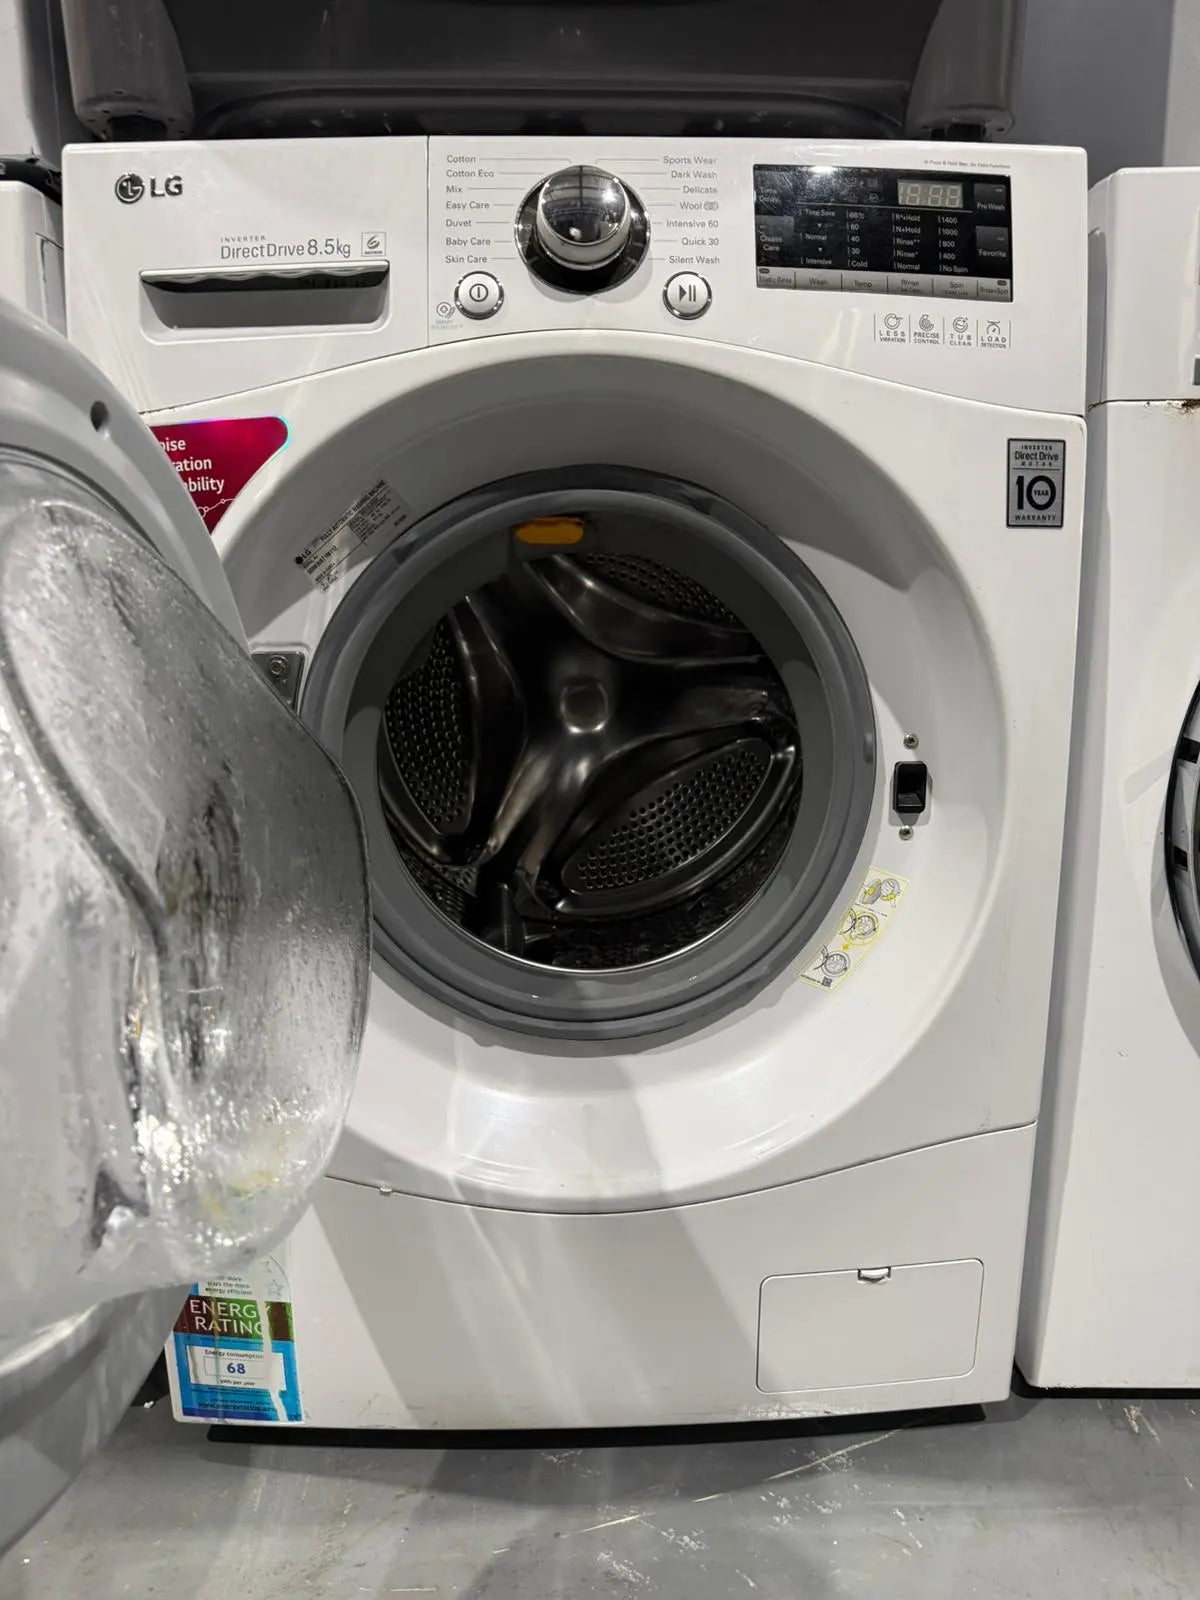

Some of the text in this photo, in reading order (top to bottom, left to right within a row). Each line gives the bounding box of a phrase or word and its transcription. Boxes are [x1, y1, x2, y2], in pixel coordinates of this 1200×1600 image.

[446, 154, 477, 164] Cotton
[663, 155, 717, 165] Sports Wear
[446, 168, 495, 178] Cotton Eco
[671, 170, 718, 180] Dark Wash
[150, 175, 183, 198] LG
[446, 185, 463, 194] Mix
[683, 185, 718, 195] Delicate
[446, 200, 490, 211] Easy Care
[680, 201, 703, 210] Wool
[445, 219, 472, 228] Duvet
[666, 219, 719, 229] Intensive 60
[220, 235, 267, 243] INVERTER
[445, 236, 491, 247] Baby Care
[681, 237, 720, 247] Quick 30
[307, 238, 351, 258] 8.5kg
[445, 255, 488, 264] Skin Care
[668, 256, 720, 265] Silent Wash
[850, 259, 868, 268] Cold
[913, 331, 940, 339] PRECISE
[950, 333, 972, 341] TUB
[981, 335, 1007, 343] LOAD
[1014, 450, 1059, 461] Direct Drive
[1015, 474, 1057, 511] 10
[1033, 489, 1050, 497] YEAR
[1015, 513, 1057, 522] WARRANTY
[205, 1349, 225, 1358] Energy
[227, 1362, 246, 1374] 68
